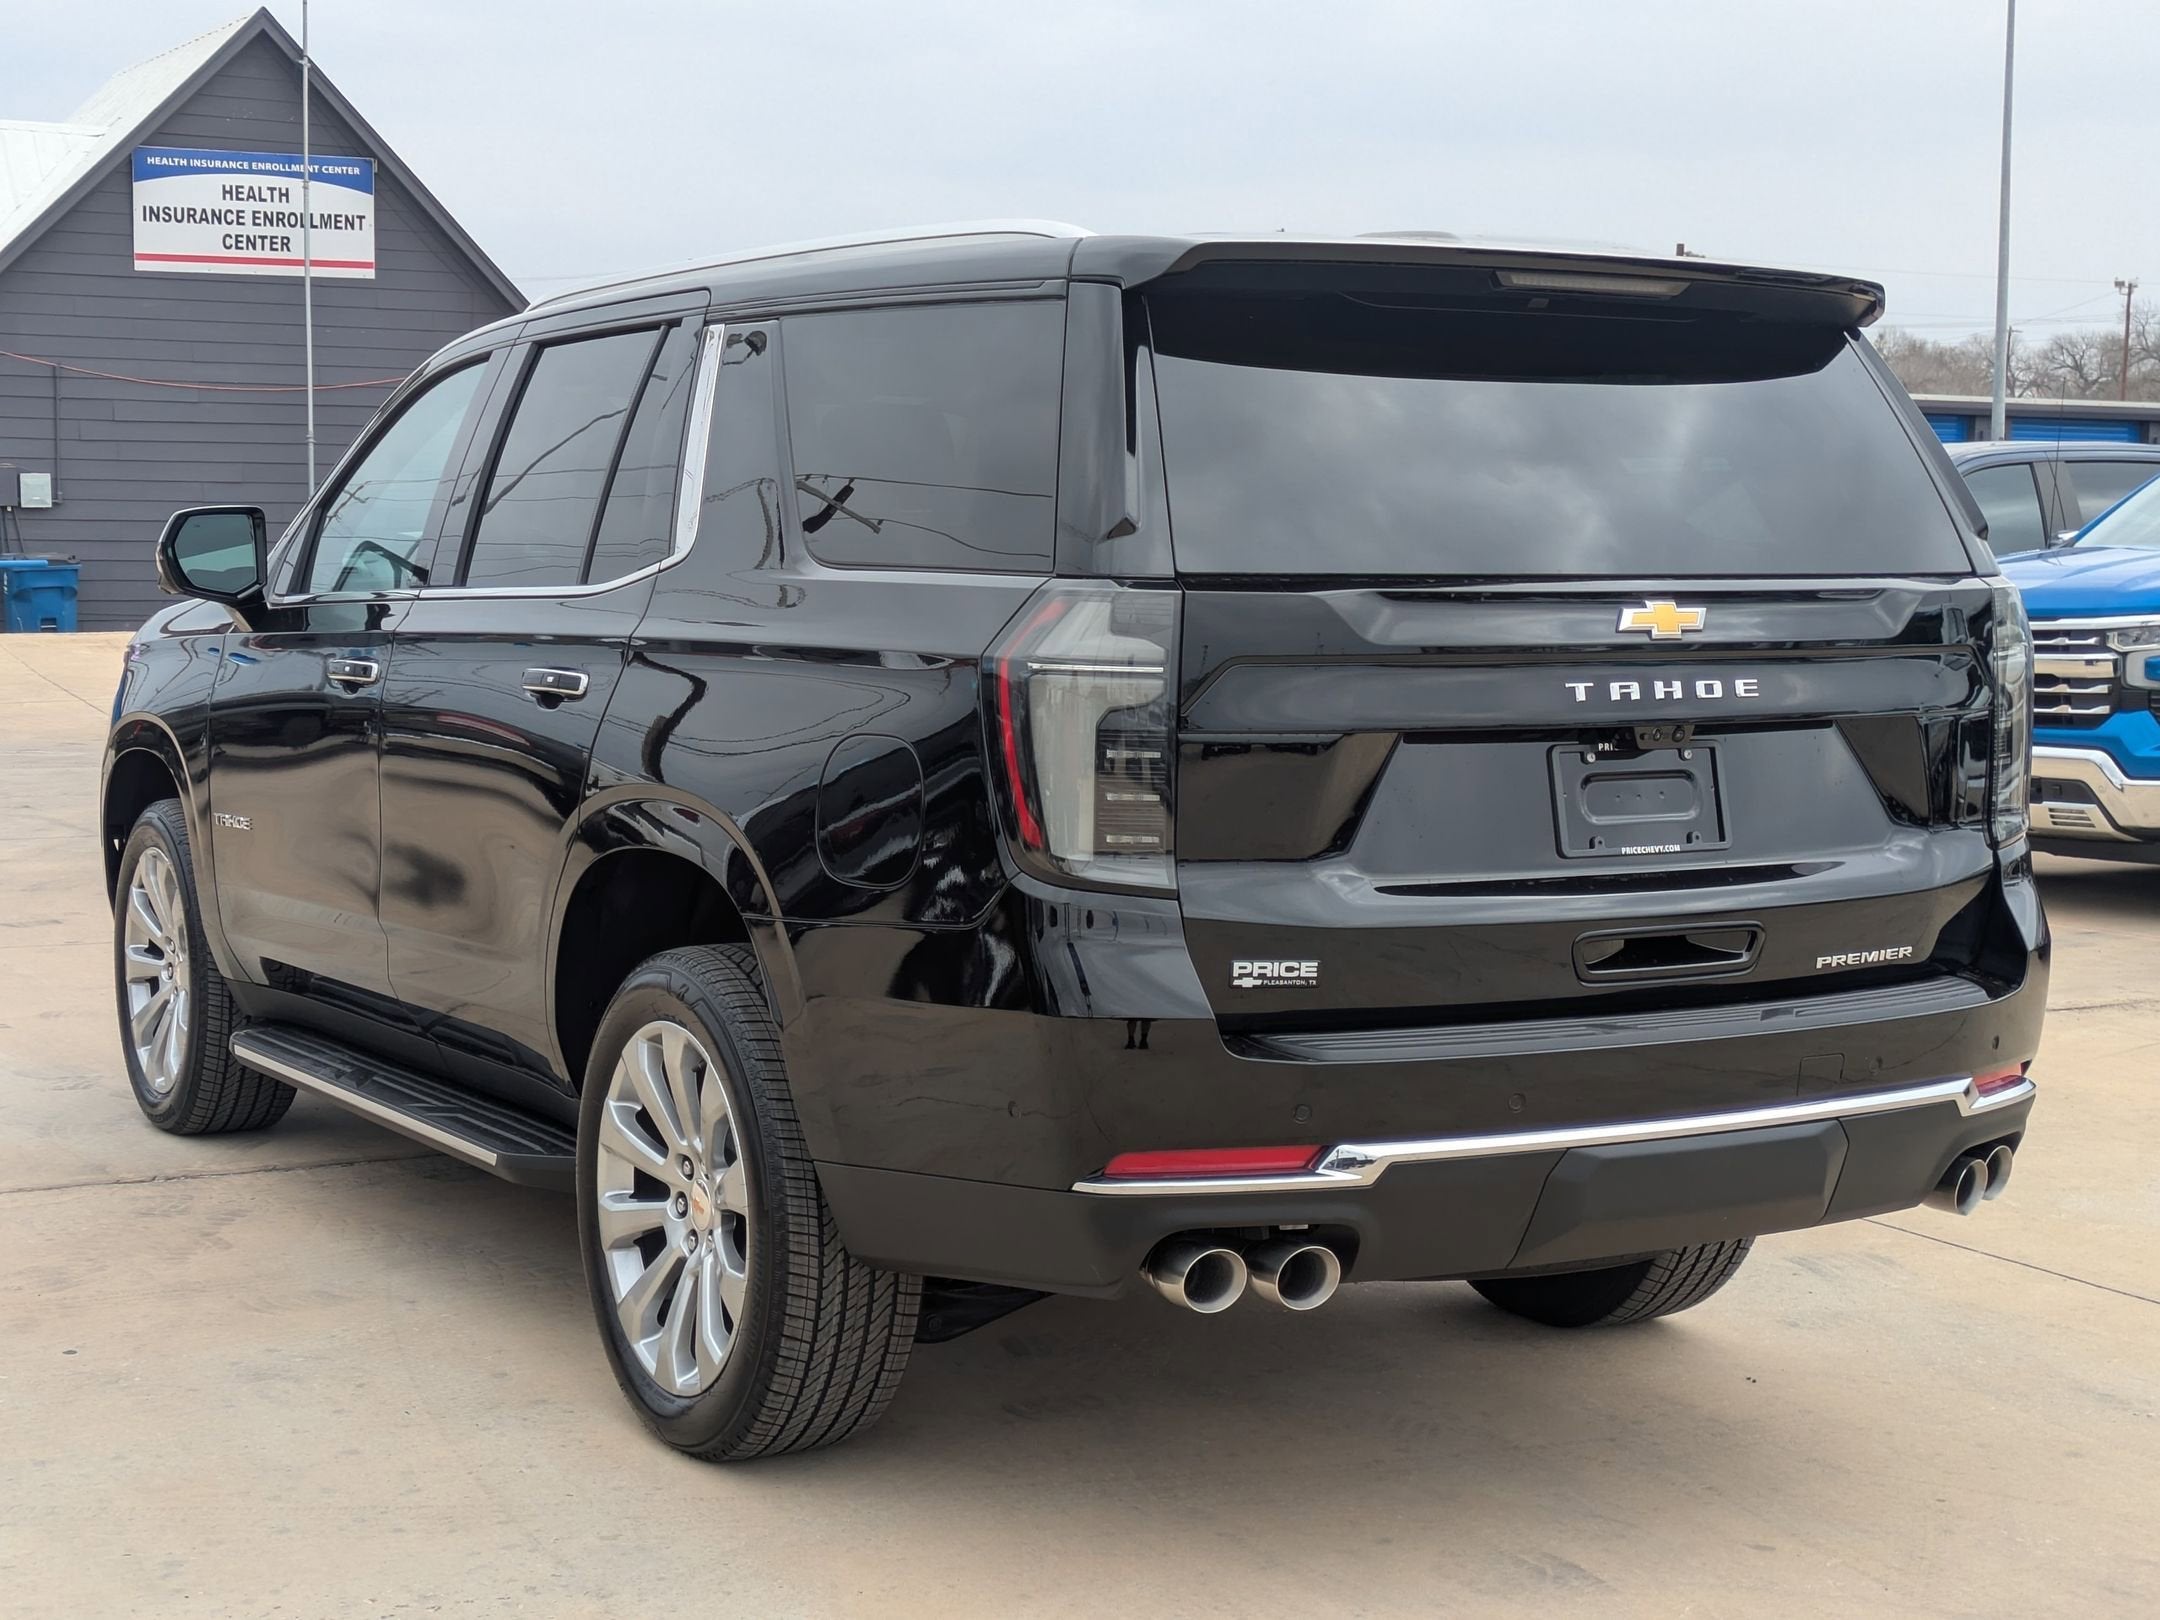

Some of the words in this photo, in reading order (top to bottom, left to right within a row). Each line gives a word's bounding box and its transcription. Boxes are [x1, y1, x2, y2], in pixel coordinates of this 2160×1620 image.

[147, 156, 188, 167] HEALTH
[190, 158, 249, 170] INSURANCE
[252, 161, 320, 173] ENROLLMENT
[321, 165, 360, 175] CENTER
[222, 184, 290, 204] HEALTH
[142, 205, 246, 226] INSURANCE
[252, 209, 366, 231] ENROLLMENT
[222, 233, 291, 252] CENTER
[1565, 679, 1760, 702] TAHOE
[213, 812, 251, 831] TAHOE
[1621, 844, 1681, 855] PRICECHEVY.COM
[1815, 946, 1913, 969] PREMIER
[1232, 962, 1319, 977] PRICE
